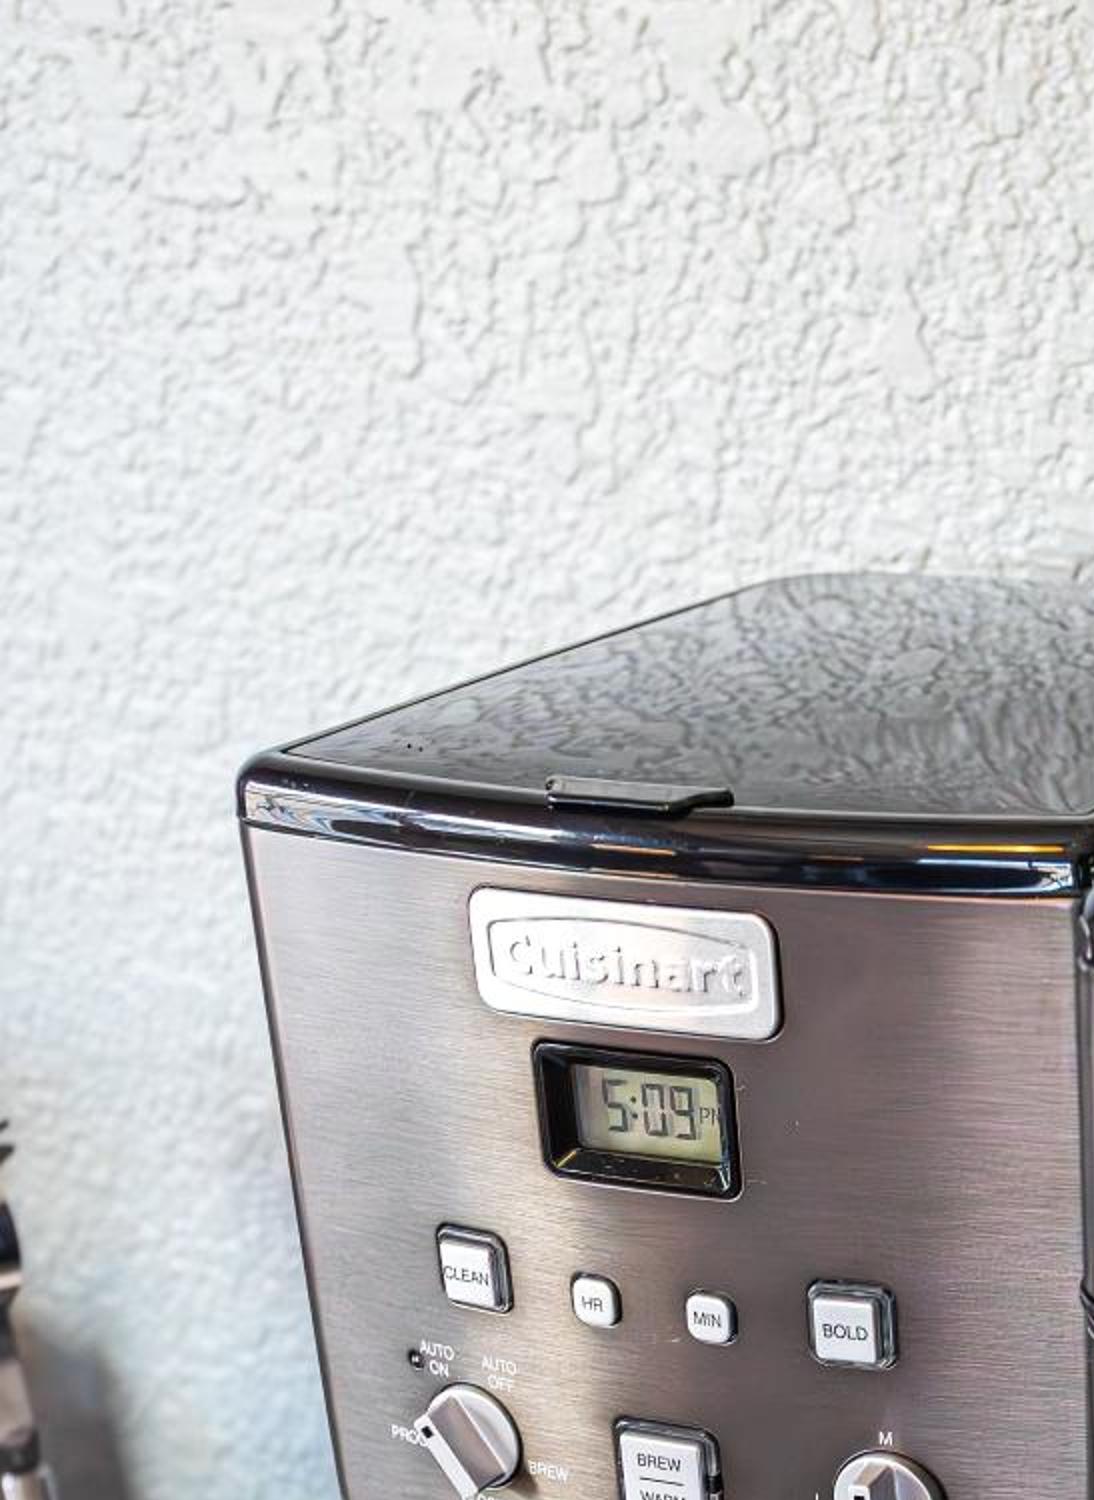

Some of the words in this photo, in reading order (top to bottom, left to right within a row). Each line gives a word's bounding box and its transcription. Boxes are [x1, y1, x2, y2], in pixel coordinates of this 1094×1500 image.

[509, 934, 746, 998] Cuisinart
[602, 1078, 698, 1141] 5:09
[443, 1265, 489, 1286] CLEAN
[581, 1294, 603, 1312] HR
[693, 1311, 721, 1329] MIN
[822, 1323, 868, 1342] BOLD
[419, 1339, 454, 1361] AUTO
[429, 1362, 449, 1377] ON
[481, 1356, 517, 1376] AUTO
[487, 1376, 514, 1392] OFF
[879, 1432, 893, 1446] M
[528, 1460, 569, 1482] BREW
[637, 1452, 682, 1472] BREW
